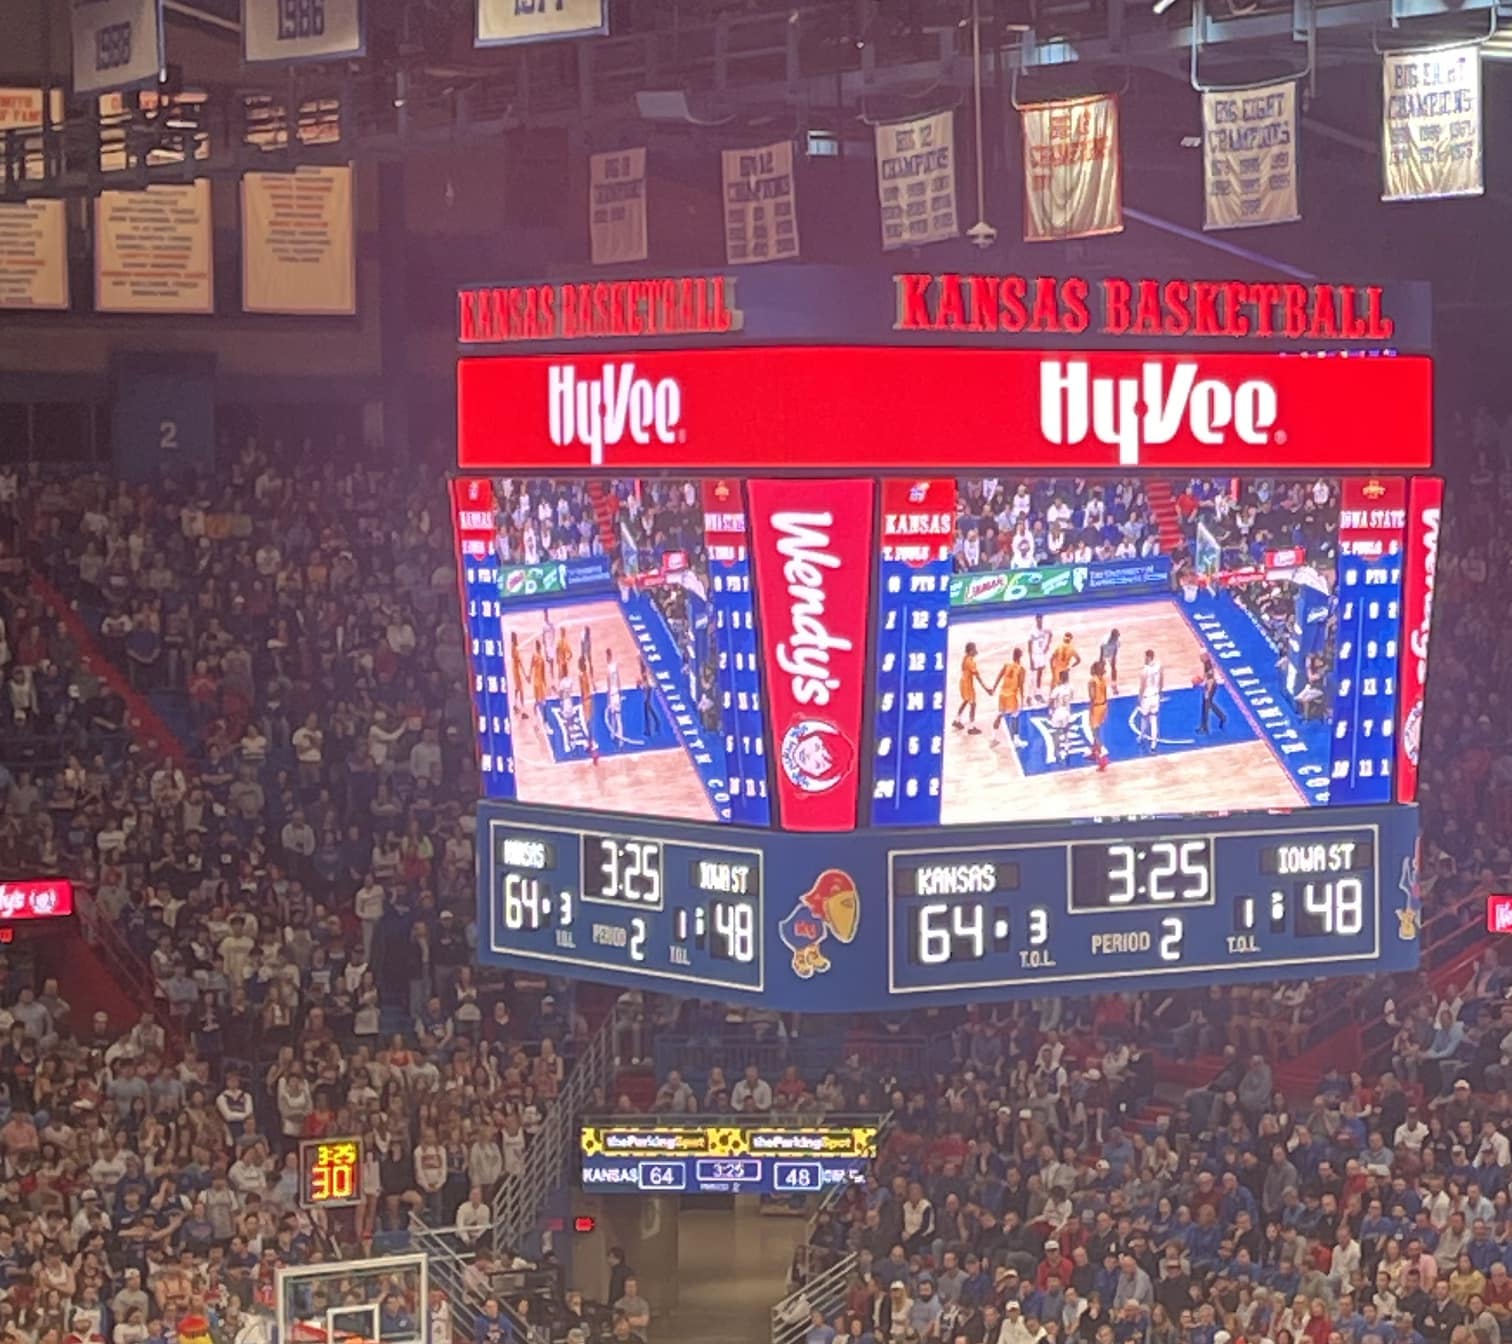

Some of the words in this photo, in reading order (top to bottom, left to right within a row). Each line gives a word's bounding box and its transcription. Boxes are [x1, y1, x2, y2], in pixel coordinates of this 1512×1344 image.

[1395, 64, 1418, 89] BIG
[1243, 93, 1285, 122] EIGHT
[458, 287, 557, 343] KANSAS
[561, 275, 733, 338] BASKETBALL
[894, 274, 1091, 336] KANSAS
[1102, 276, 1393, 341] BASKETBALL
[1039, 361, 1279, 467] HyVee
[159, 420, 178, 449] 2
[884, 514, 951, 535] KANSAS
[1340, 511, 1368, 529] IOWA
[1369, 510, 1405, 529] STATE
[910, 575, 936, 592] PTS
[770, 511, 853, 706] Wendy's
[600, 839, 660, 903] 3:25
[1108, 842, 1209, 903] 3:25
[1278, 846, 1325, 875] IOWA
[1327, 844, 1355, 870] ST
[731, 867, 749, 895] ST
[917, 865, 996, 895] KANSAS
[505, 874, 539, 929] 64
[559, 891, 572, 926] 3
[1244, 898, 1253, 928] 1
[1305, 878, 1362, 935] 48
[592, 924, 627, 947] PERIOD
[630, 917, 646, 961] 2
[680, 909, 687, 940] 1
[715, 903, 753, 962] 48
[919, 903, 984, 963] 64
[1028, 909, 1048, 944] 3
[1160, 918, 1182, 961] 2
[1091, 931, 1151, 955] PERIOD
[1226, 935, 1262, 954] T.O.L.
[1019, 951, 1056, 969] T.O.L.
[318, 1143, 357, 1165] 3:25
[312, 1165, 353, 1200] 30
[582, 1168, 638, 1183] KANSAS
[650, 1167, 674, 1184] 64
[713, 1163, 745, 1178] 3:25
[785, 1169, 810, 1186] 48
